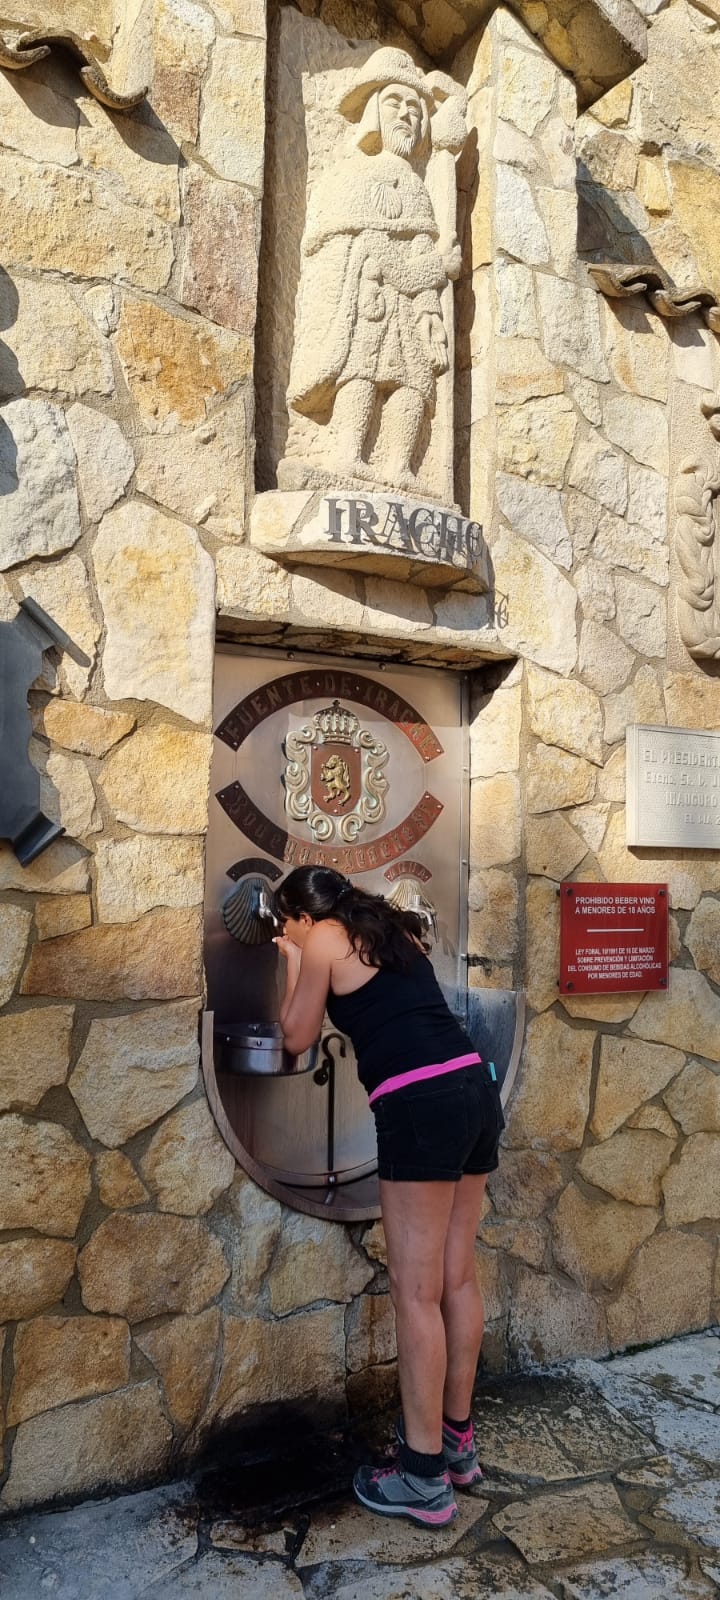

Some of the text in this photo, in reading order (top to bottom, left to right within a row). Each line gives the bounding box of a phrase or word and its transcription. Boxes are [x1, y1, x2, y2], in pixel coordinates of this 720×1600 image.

[224, 674, 433, 754] FUENTE DE IRACHE
[575, 896, 656, 905] PROHIBIDO BEBER VINO
[575, 905, 656, 914] A MENORES DE 18 AÑOS
[639, 946, 655, 954] MARZO
[577, 956, 594, 964] SOBRE
[594, 955, 624, 963] PREVENCIÓN
[628, 954, 653, 962] LIMITACIÓN
[578, 964, 602, 972] CONSUMO
